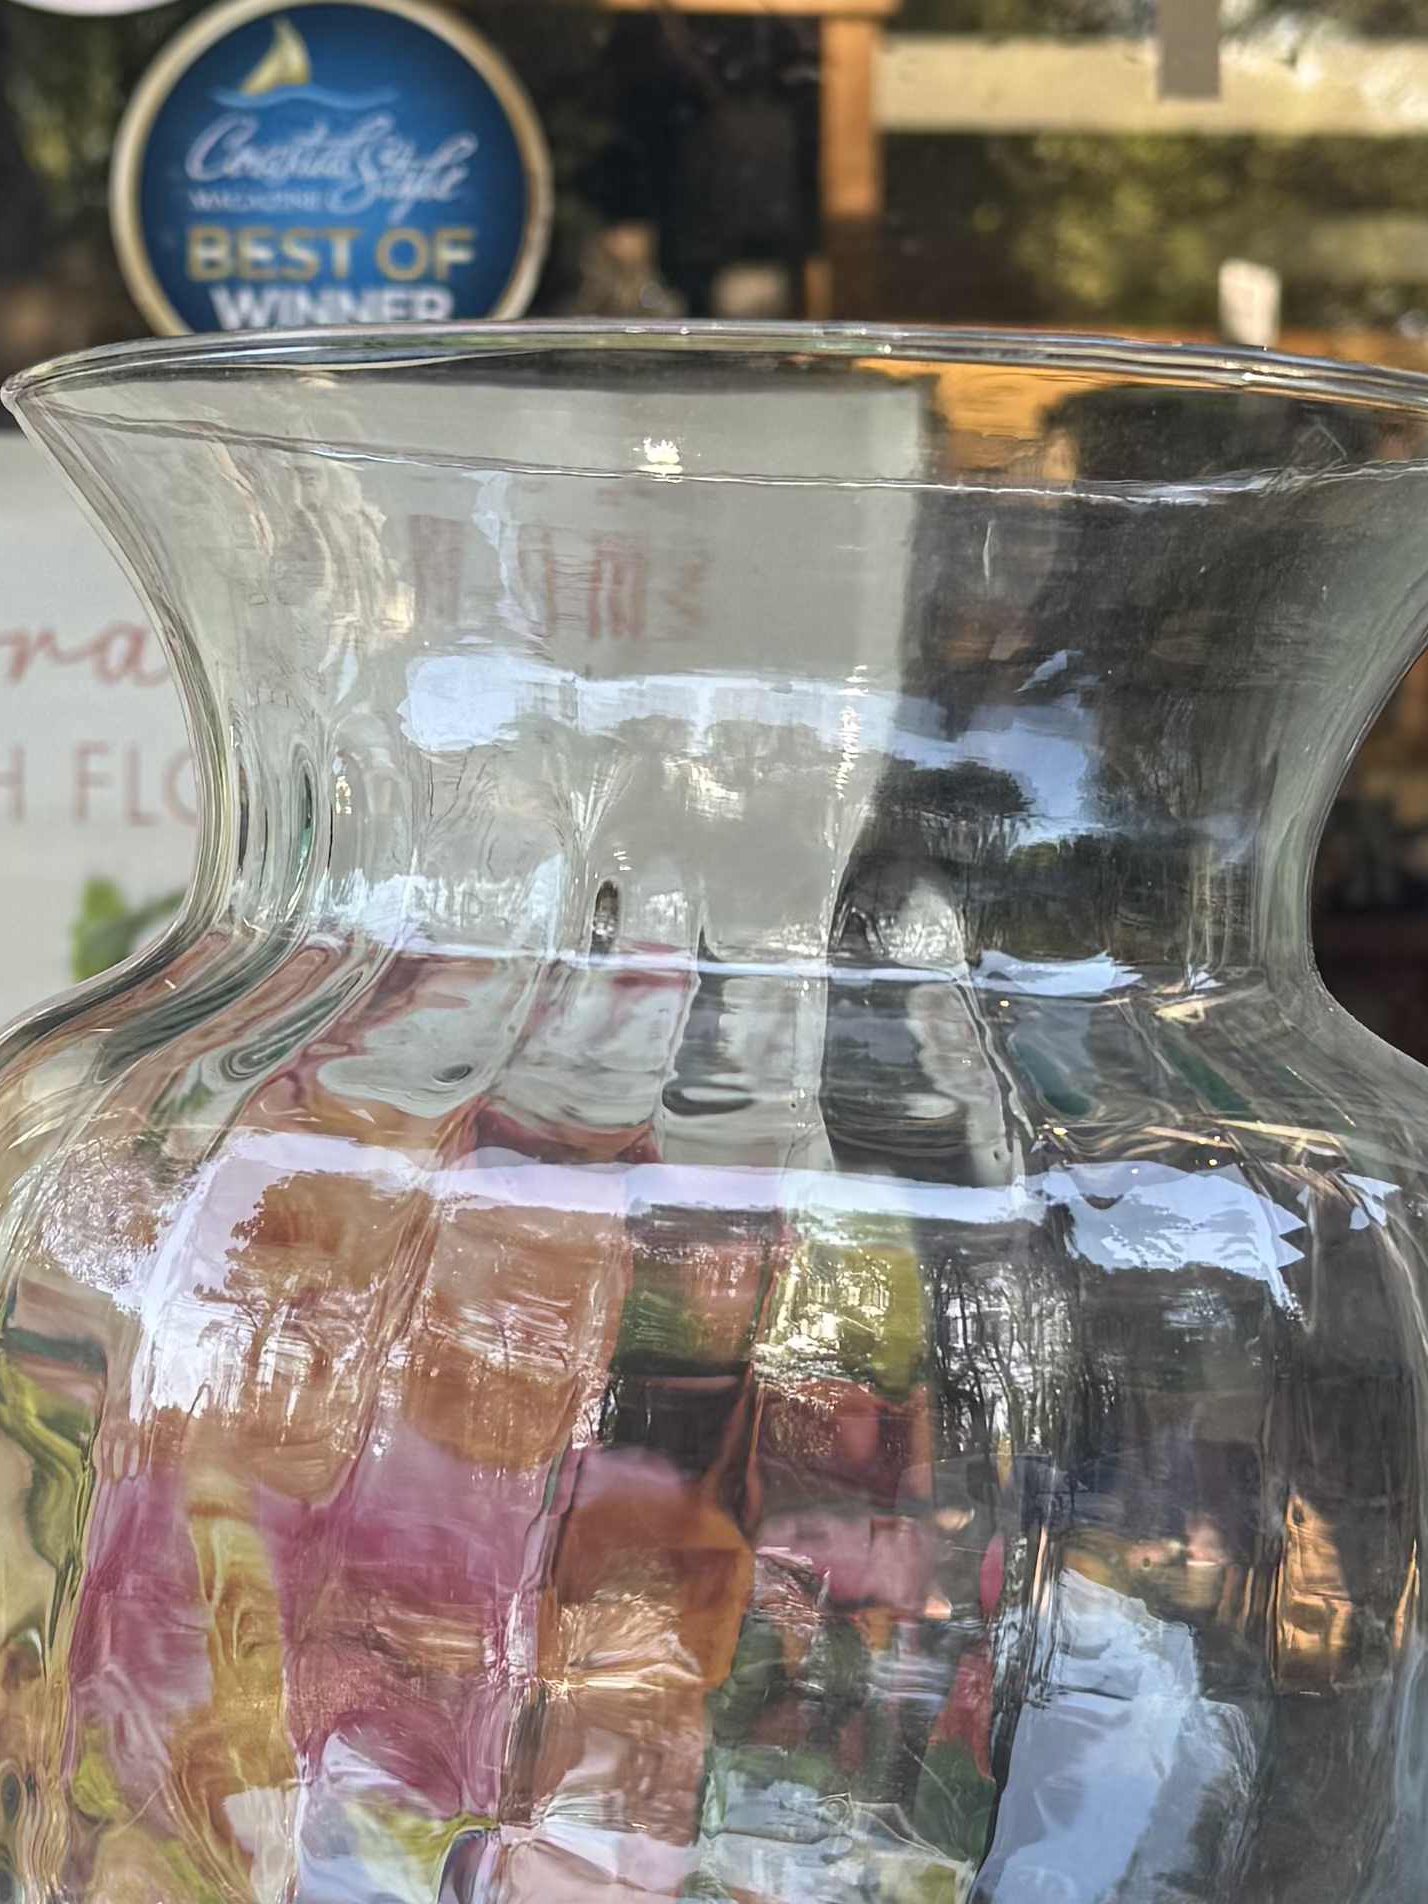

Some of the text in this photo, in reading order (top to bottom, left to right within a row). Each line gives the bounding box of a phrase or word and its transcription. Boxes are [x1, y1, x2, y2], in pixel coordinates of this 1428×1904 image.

[186, 226, 476, 283] BEST OF
[208, 285, 456, 329] WINNER
